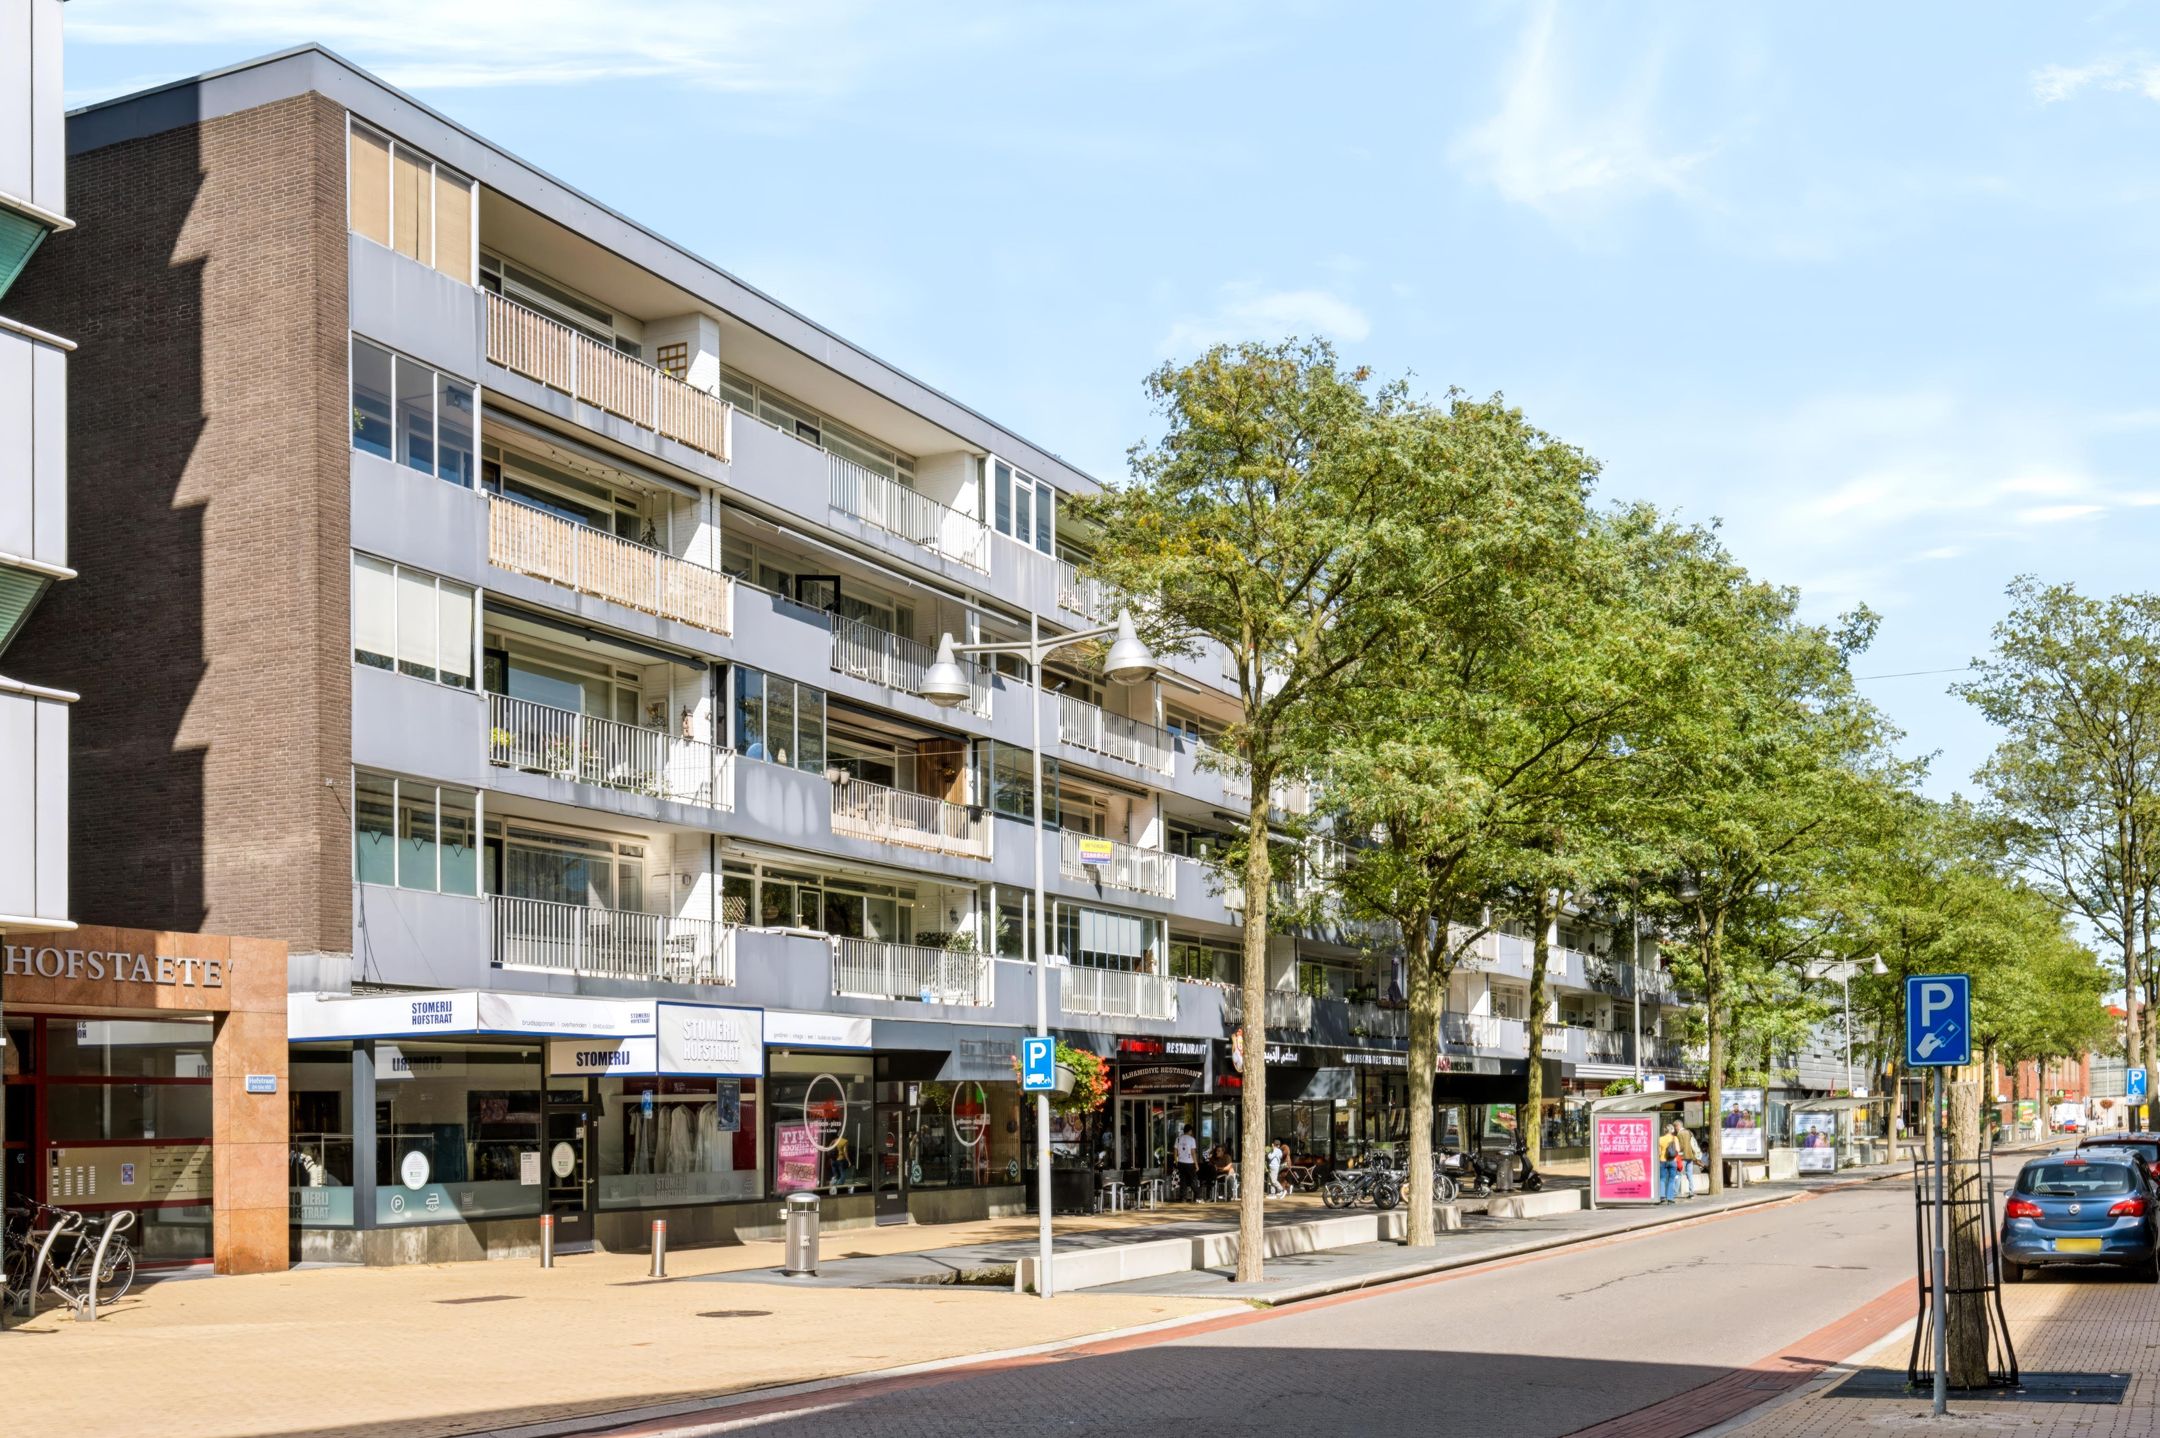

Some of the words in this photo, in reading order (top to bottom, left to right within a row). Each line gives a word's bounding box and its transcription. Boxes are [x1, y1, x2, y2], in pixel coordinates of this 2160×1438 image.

[411, 1000, 453, 1015] STOMERIJ
[1921, 983, 1954, 1027] P
[411, 1014, 453, 1026] HOFSTRAAT
[682, 1017, 740, 1043] STOMERIJ
[683, 1042, 741, 1063] HOFSTRAAT
[1029, 1042, 1047, 1069] P
[1165, 1042, 1208, 1056] RESTAURANT
[575, 1050, 631, 1067] STOMERIJ
[1160, 1066, 1203, 1079] RESTAURANT
[2131, 1071, 2143, 1085] P
[1600, 1124, 1616, 1135] IK
[1619, 1124, 1649, 1136] ZIE,
[1600, 1136, 1610, 1145] IK
[289, 1191, 329, 1206] TOMERIJ
[289, 1206, 329, 1220] OFSTRAAT
